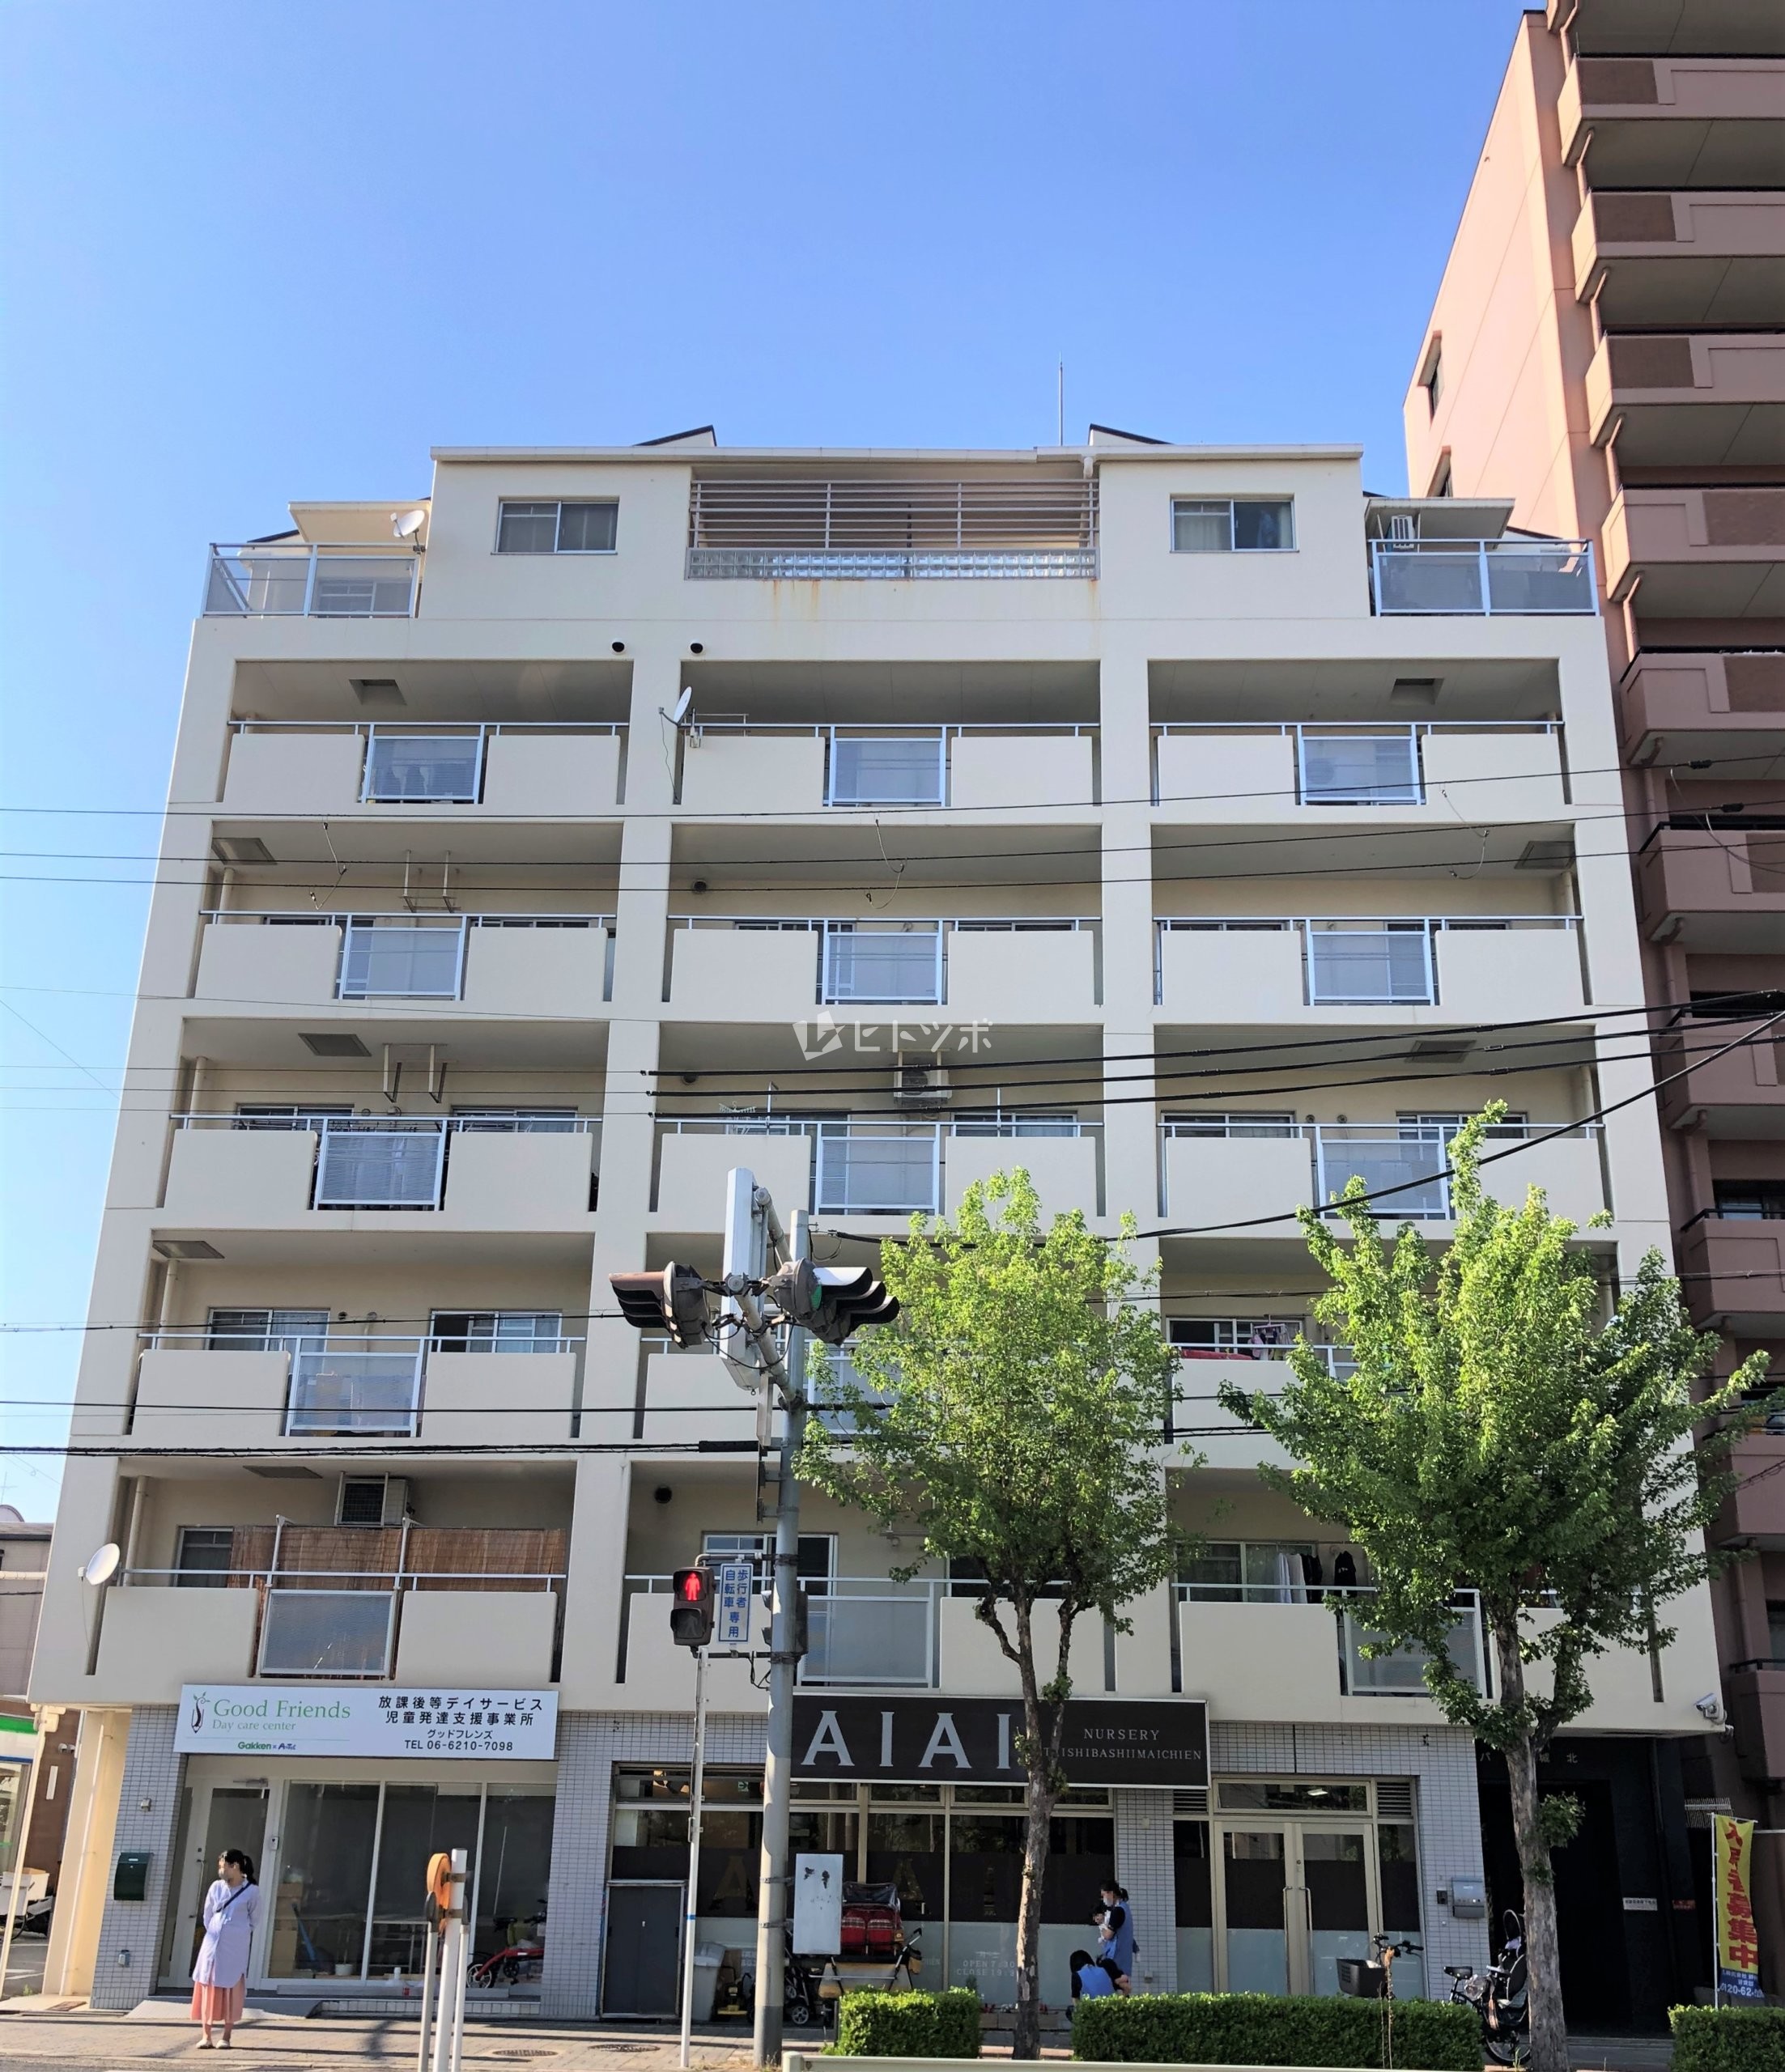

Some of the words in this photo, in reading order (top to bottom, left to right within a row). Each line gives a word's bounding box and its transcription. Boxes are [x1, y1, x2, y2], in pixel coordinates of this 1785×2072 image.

[724, 1569, 736, 1608] 自転車
[736, 1569, 749, 1608] 歩行者
[728, 1611, 741, 1638] 専用
[214, 1699, 268, 1717] Good
[276, 1700, 351, 1719] Friends
[378, 1696, 543, 1711] 放課後等デイサービス
[385, 1710, 534, 1726] 児童発達支援事業所
[212, 1719, 235, 1733] Day
[237, 1722, 260, 1730] care
[262, 1722, 296, 1731] center
[427, 1729, 494, 1740] グッドフレンズ
[801, 1710, 1011, 1770] AIAI
[1083, 1728, 1161, 1741] NURSERY
[238, 1741, 271, 1751] Gakken
[405, 1739, 423, 1749] TEL
[427, 1741, 513, 1751] 06-6210-7098
[1043, 1746, 1202, 1760] TISHIBASHIIMAICHIEN
